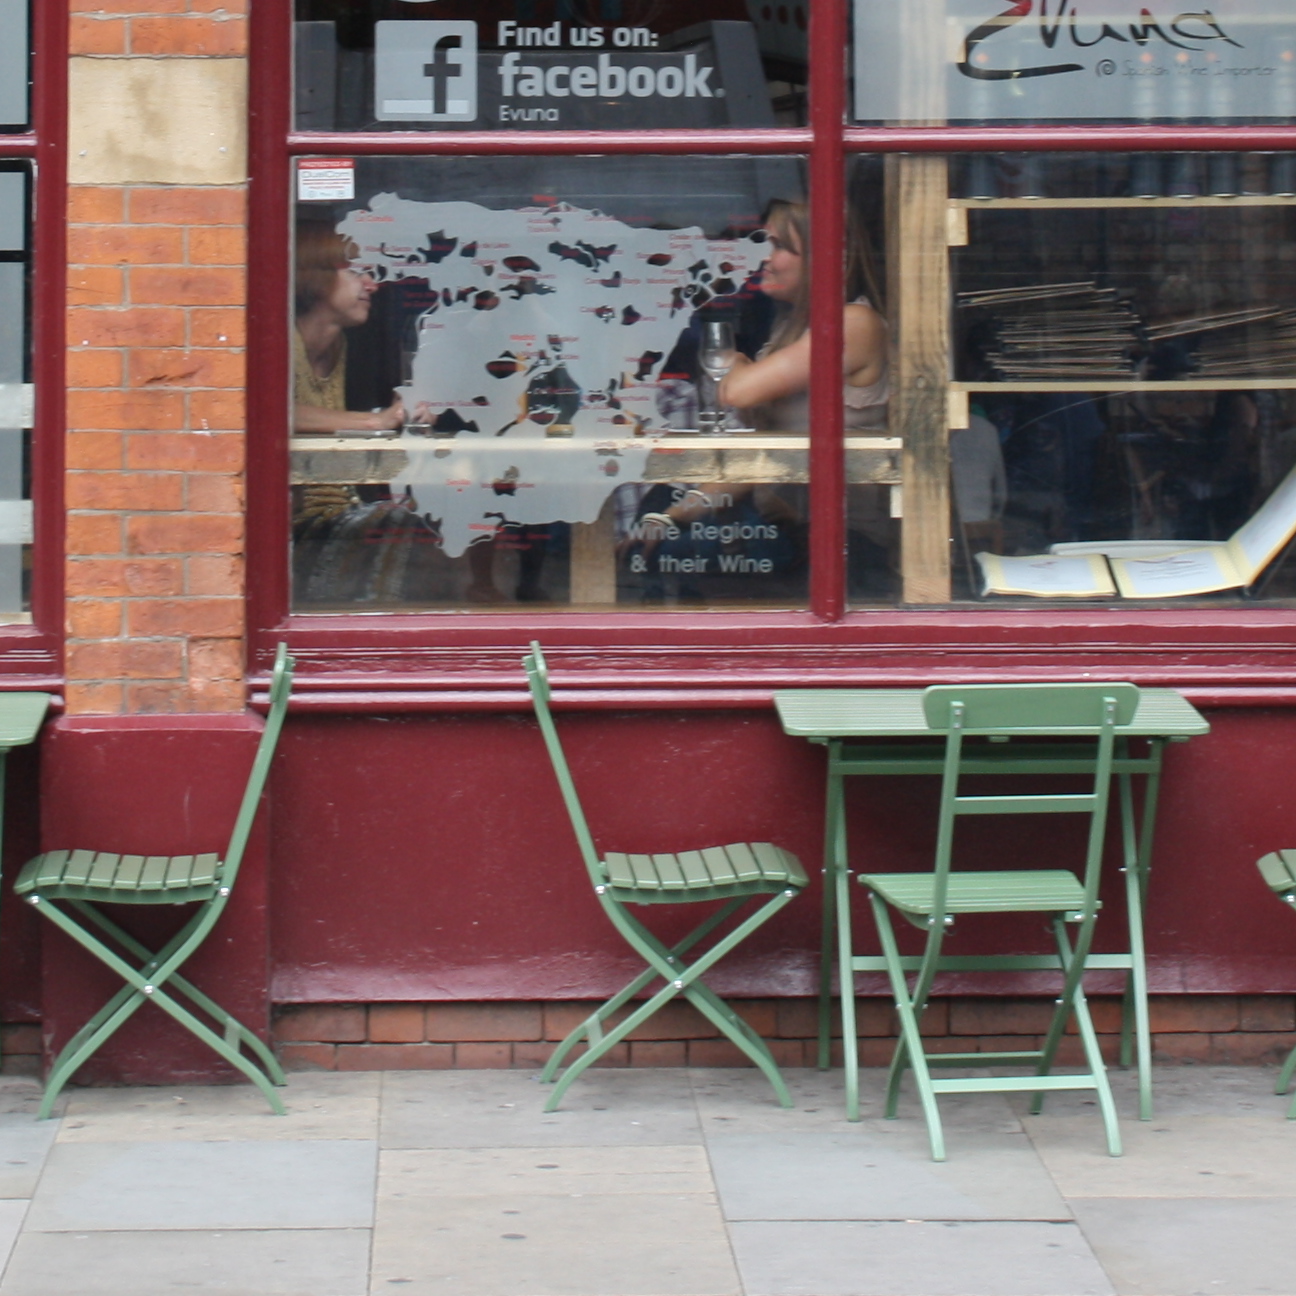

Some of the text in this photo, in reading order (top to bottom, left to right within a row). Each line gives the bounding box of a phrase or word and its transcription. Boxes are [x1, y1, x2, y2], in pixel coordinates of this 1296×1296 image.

[497, 21, 659, 46] Find us on:
[500, 105, 560, 121] Evuna
[627, 522, 778, 544] Wine Regions
[630, 555, 774, 573] & their Wine
